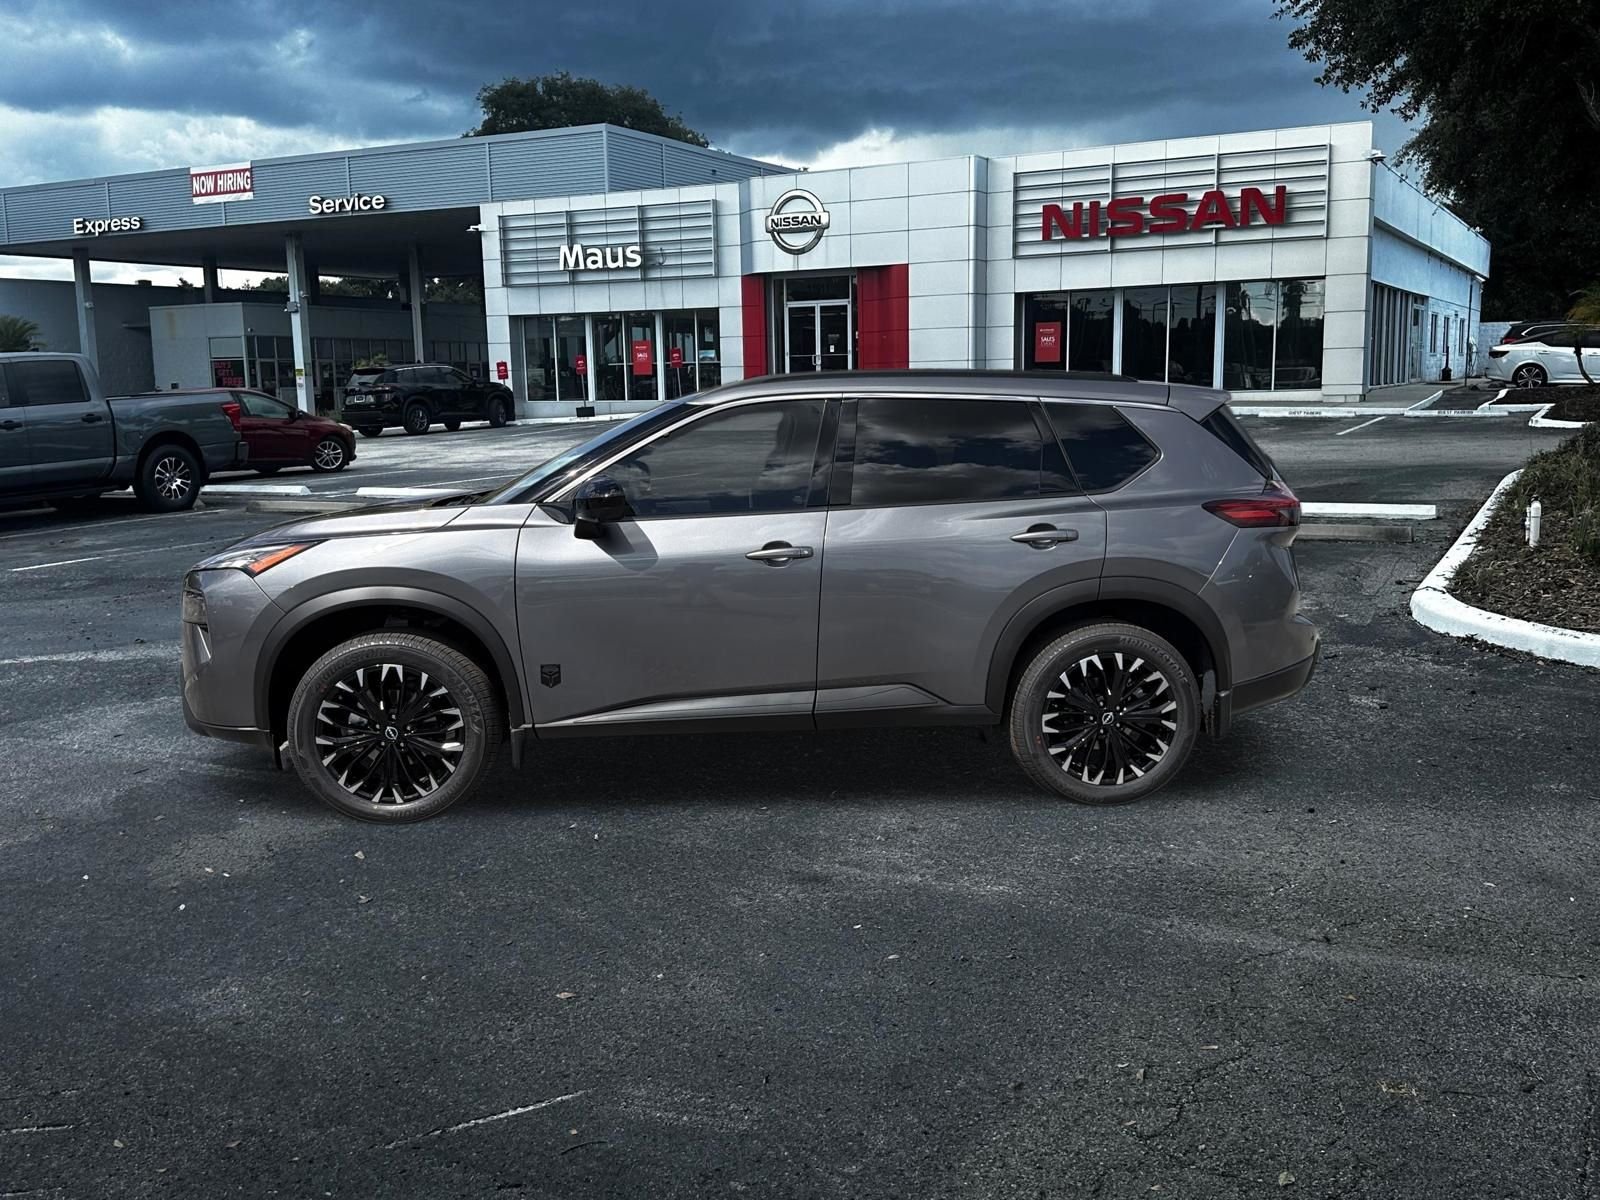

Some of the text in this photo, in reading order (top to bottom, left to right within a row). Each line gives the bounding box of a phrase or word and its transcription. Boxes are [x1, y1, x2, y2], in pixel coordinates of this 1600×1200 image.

[192, 170, 252, 195] NOW HIRING
[308, 193, 386, 215] Service
[1041, 185, 1287, 241] NISSAN
[73, 215, 141, 237] Express
[770, 213, 823, 230] NISSAN
[559, 242, 642, 271] Maus
